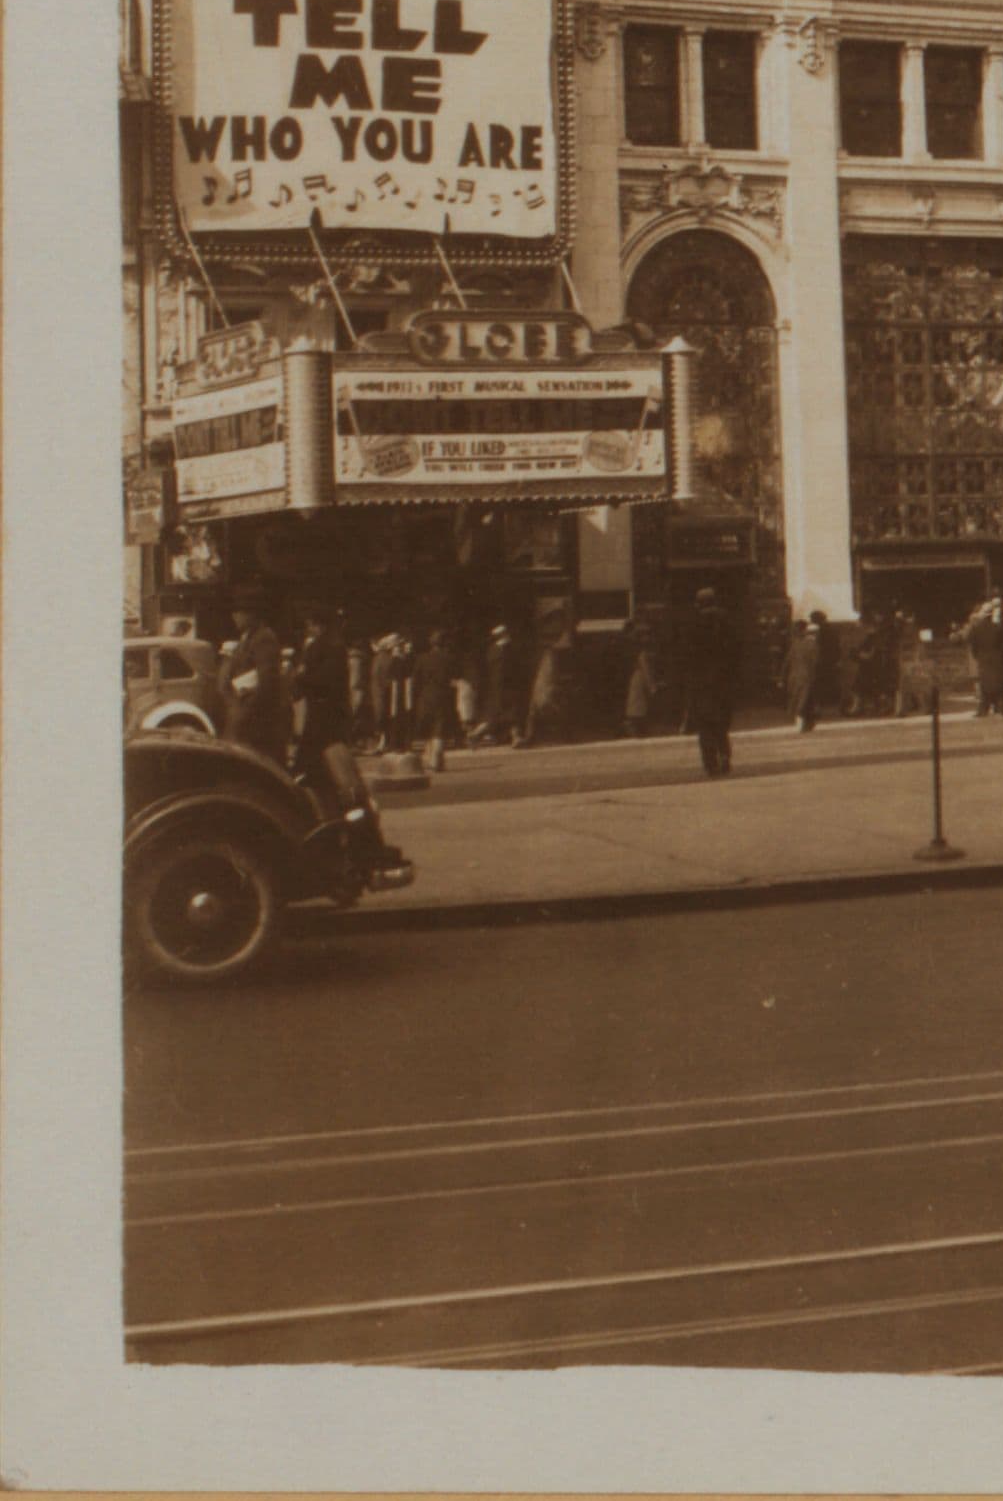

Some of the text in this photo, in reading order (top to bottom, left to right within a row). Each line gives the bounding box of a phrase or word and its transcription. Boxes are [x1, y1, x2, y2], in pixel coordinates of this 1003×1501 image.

[288, 54, 442, 115] ME
[180, 115, 544, 171] WHO YOU ARE
[414, 322, 588, 362] GLOBE
[428, 380, 464, 394] FIRST
[474, 380, 526, 393] MUSICAL
[537, 380, 603, 393] SENSATION
[421, 440, 436, 456] IF
[441, 440, 466, 456] YOU
[471, 439, 506, 456] LIKED
